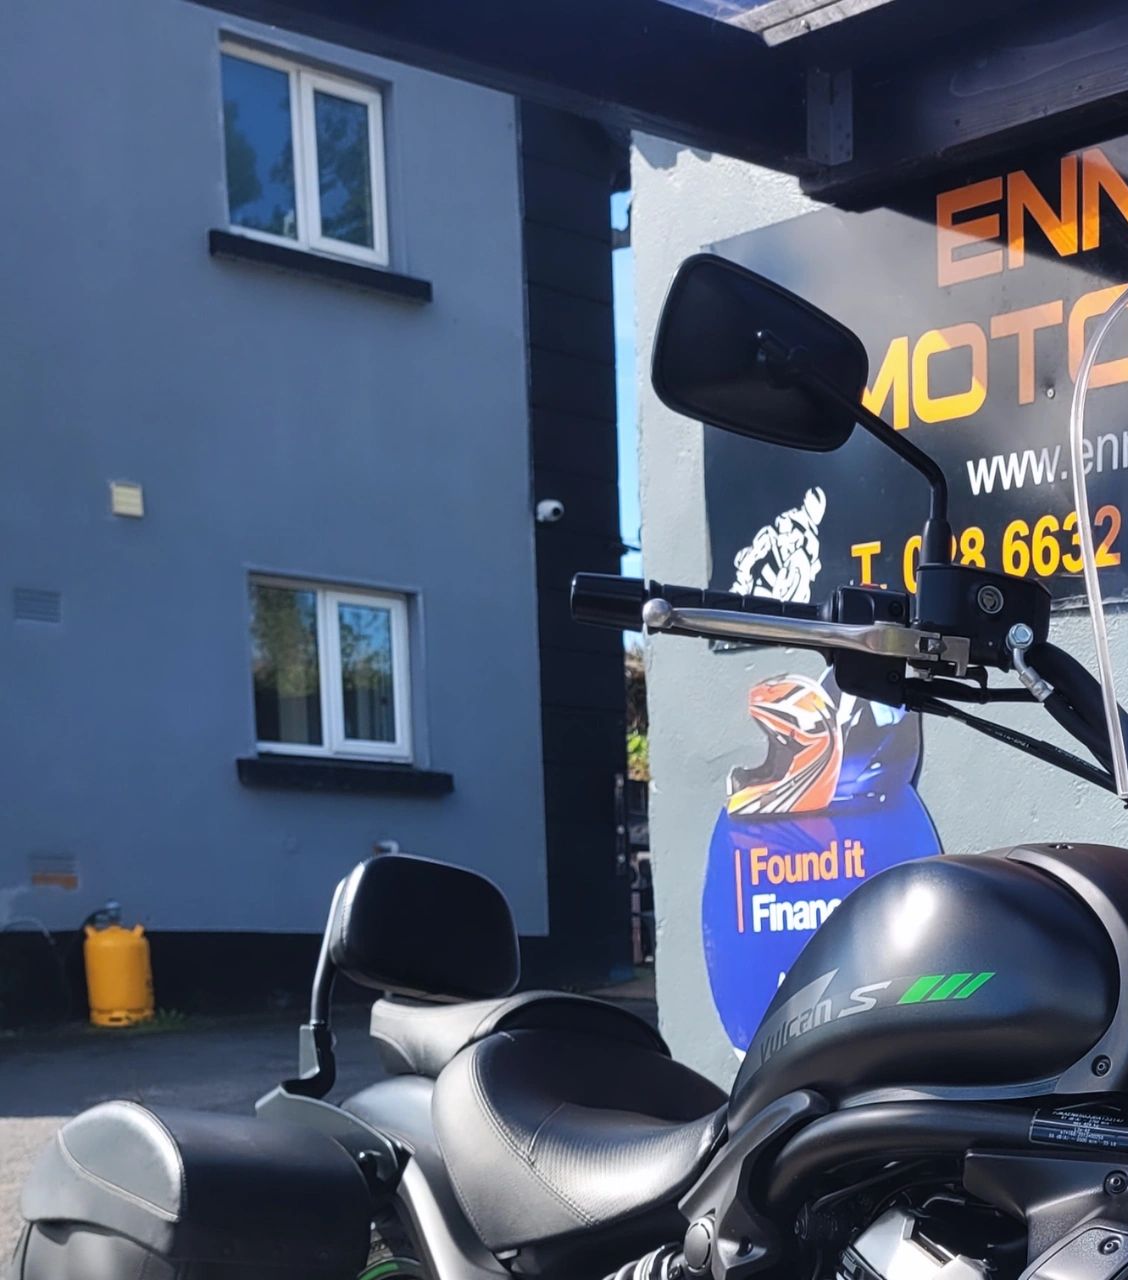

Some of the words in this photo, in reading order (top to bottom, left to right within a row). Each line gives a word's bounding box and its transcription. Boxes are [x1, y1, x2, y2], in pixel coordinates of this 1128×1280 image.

[851, 541, 888, 590] T.
[903, 526, 986, 595] 08
[1002, 504, 1122, 578] 6632
[750, 840, 839, 886] Found
[844, 839, 866, 879] it
[837, 980, 893, 1019] S
